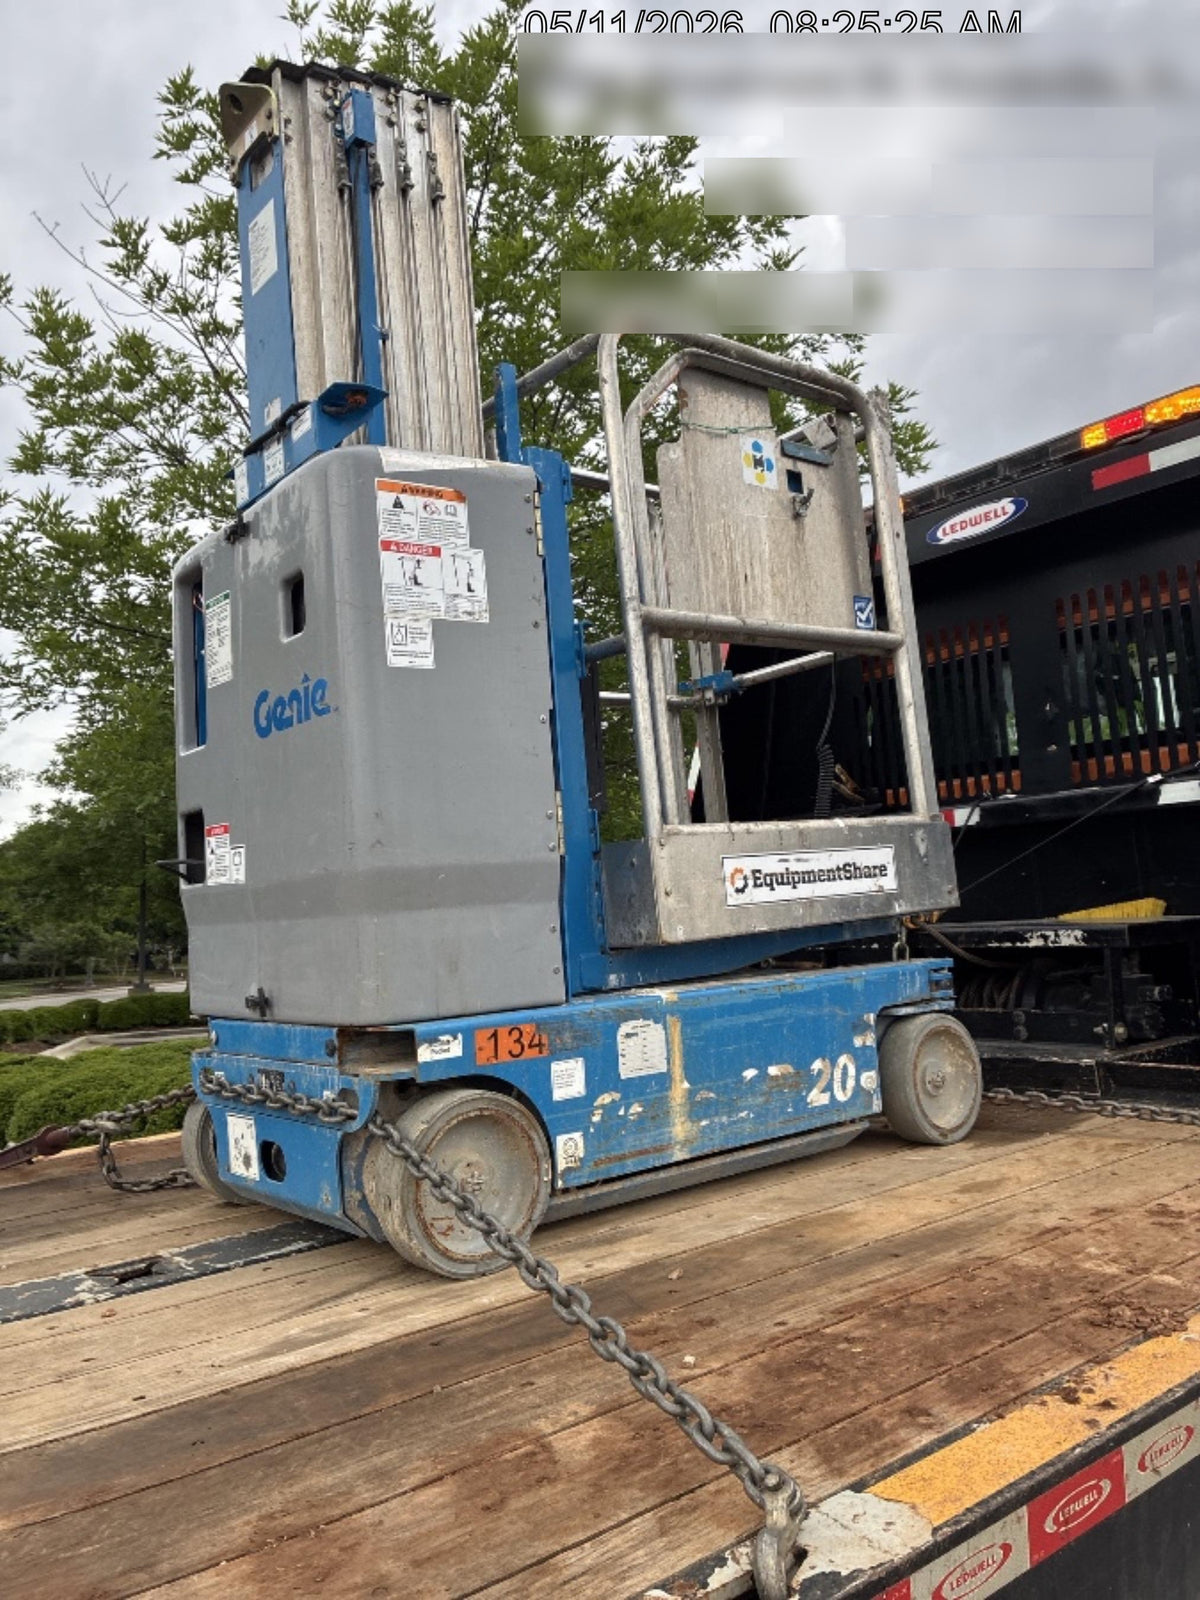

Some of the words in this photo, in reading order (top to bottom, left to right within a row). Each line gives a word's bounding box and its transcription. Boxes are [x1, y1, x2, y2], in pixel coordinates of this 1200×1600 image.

[941, 505, 1010, 537] LEDWELL
[254, 673, 331, 738] Genie
[752, 862, 888, 891] EquipmentShare
[807, 1053, 856, 1107] 20
[1059, 1489, 1099, 1522] LEDWELL
[949, 1554, 998, 1592] LEDWELL
